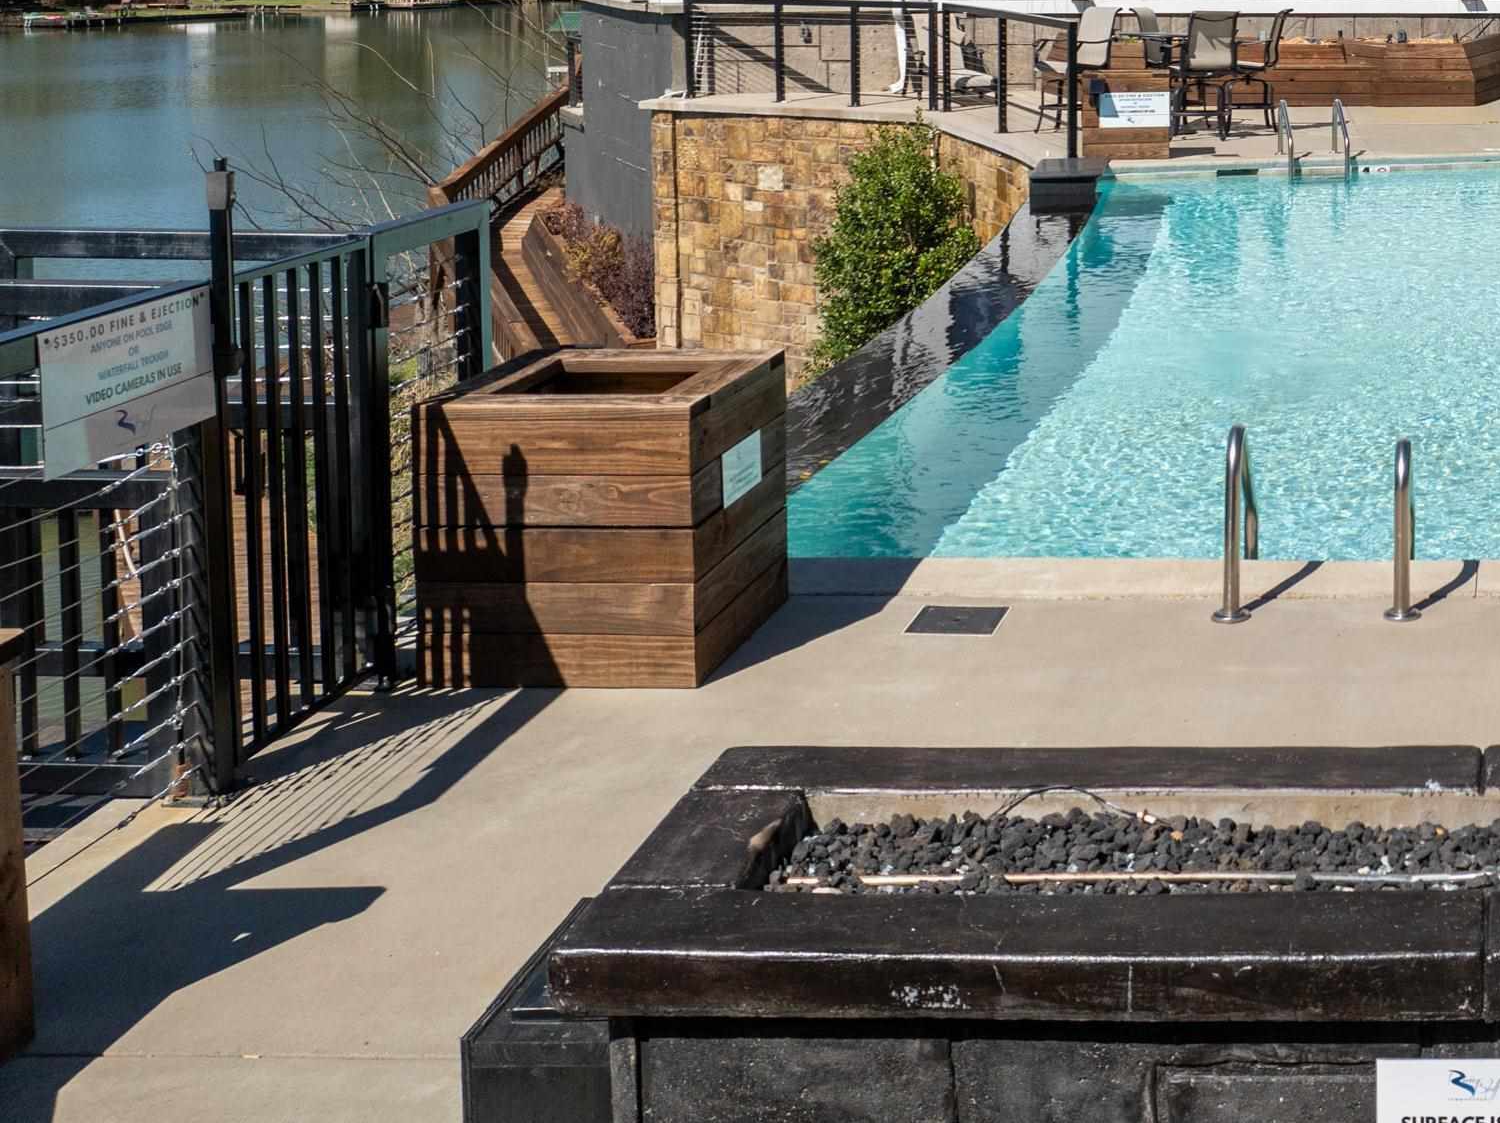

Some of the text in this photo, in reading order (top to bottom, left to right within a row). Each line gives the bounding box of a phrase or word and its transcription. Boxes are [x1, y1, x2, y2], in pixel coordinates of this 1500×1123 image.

[109, 314, 136, 333] FINE
[138, 311, 148, 324] &
[89, 335, 121, 354] ANYONE
[122, 331, 135, 344] ON
[135, 324, 155, 340] POOL
[85, 362, 183, 405] VIDEO CAMERAS IN USE
